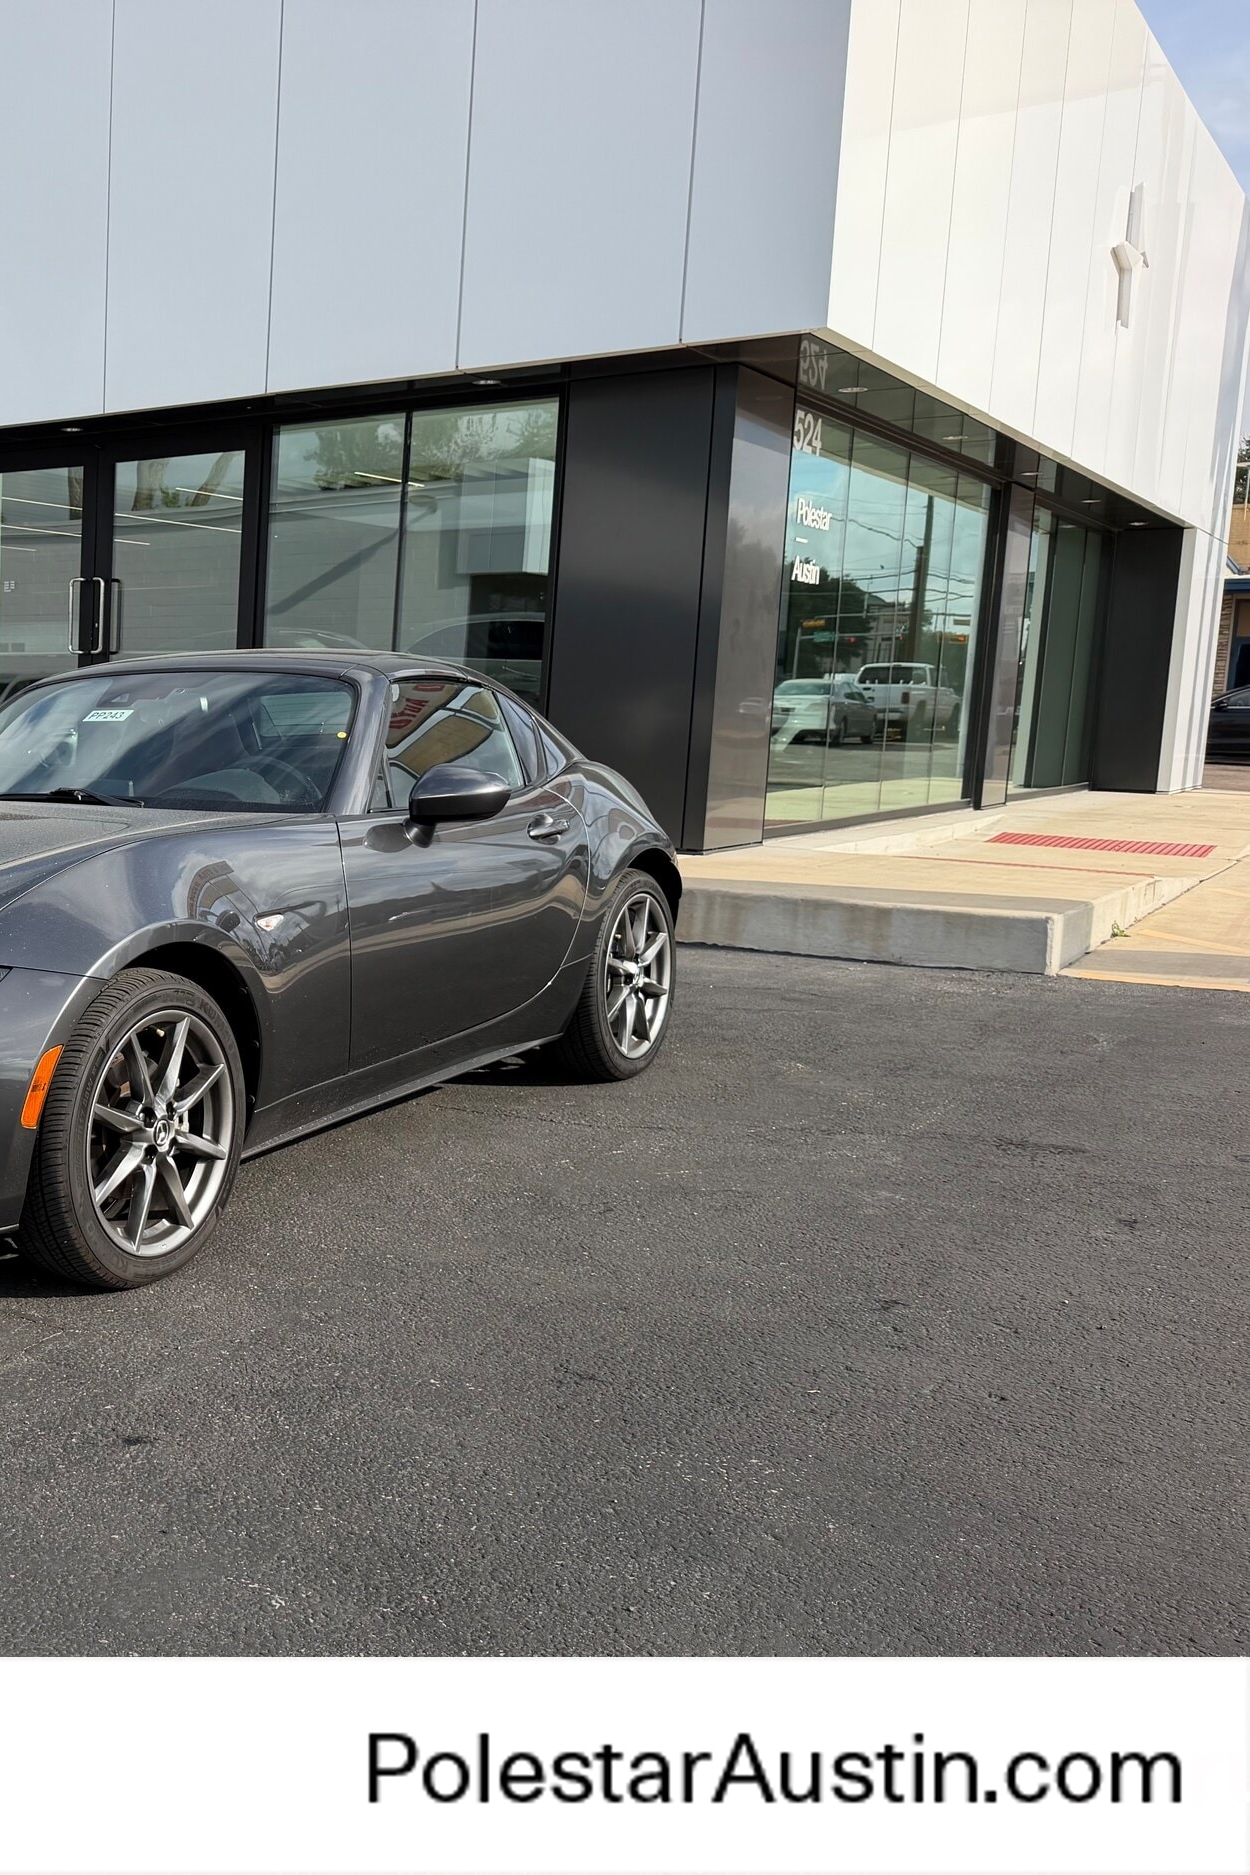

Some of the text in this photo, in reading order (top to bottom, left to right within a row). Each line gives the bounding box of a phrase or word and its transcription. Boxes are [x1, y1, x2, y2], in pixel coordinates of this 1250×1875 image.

[793, 410, 823, 457] 524
[797, 498, 832, 531] Polestar
[791, 556, 820, 585] Austin
[88, 711, 125, 720] PP243
